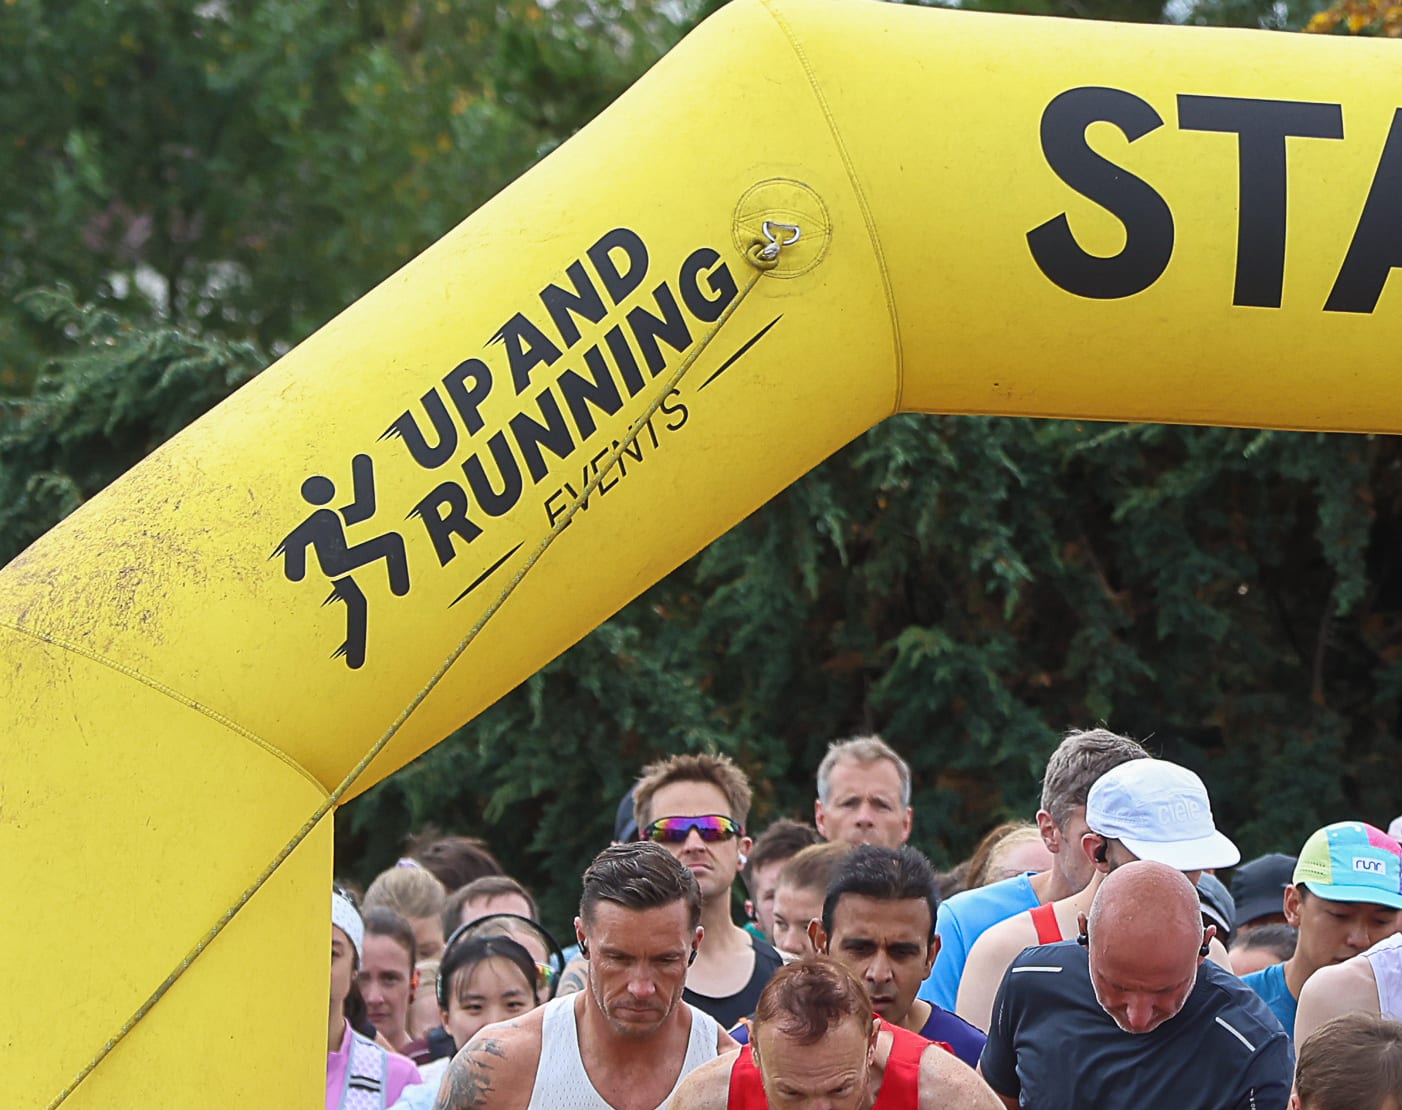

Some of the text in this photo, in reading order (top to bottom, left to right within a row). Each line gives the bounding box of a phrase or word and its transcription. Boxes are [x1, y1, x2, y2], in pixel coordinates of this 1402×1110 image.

[380, 228, 650, 470] UP AND
[404, 247, 739, 568] RUNNING
[544, 387, 689, 537] EVENTS
[1355, 860, 1383, 872] runr
